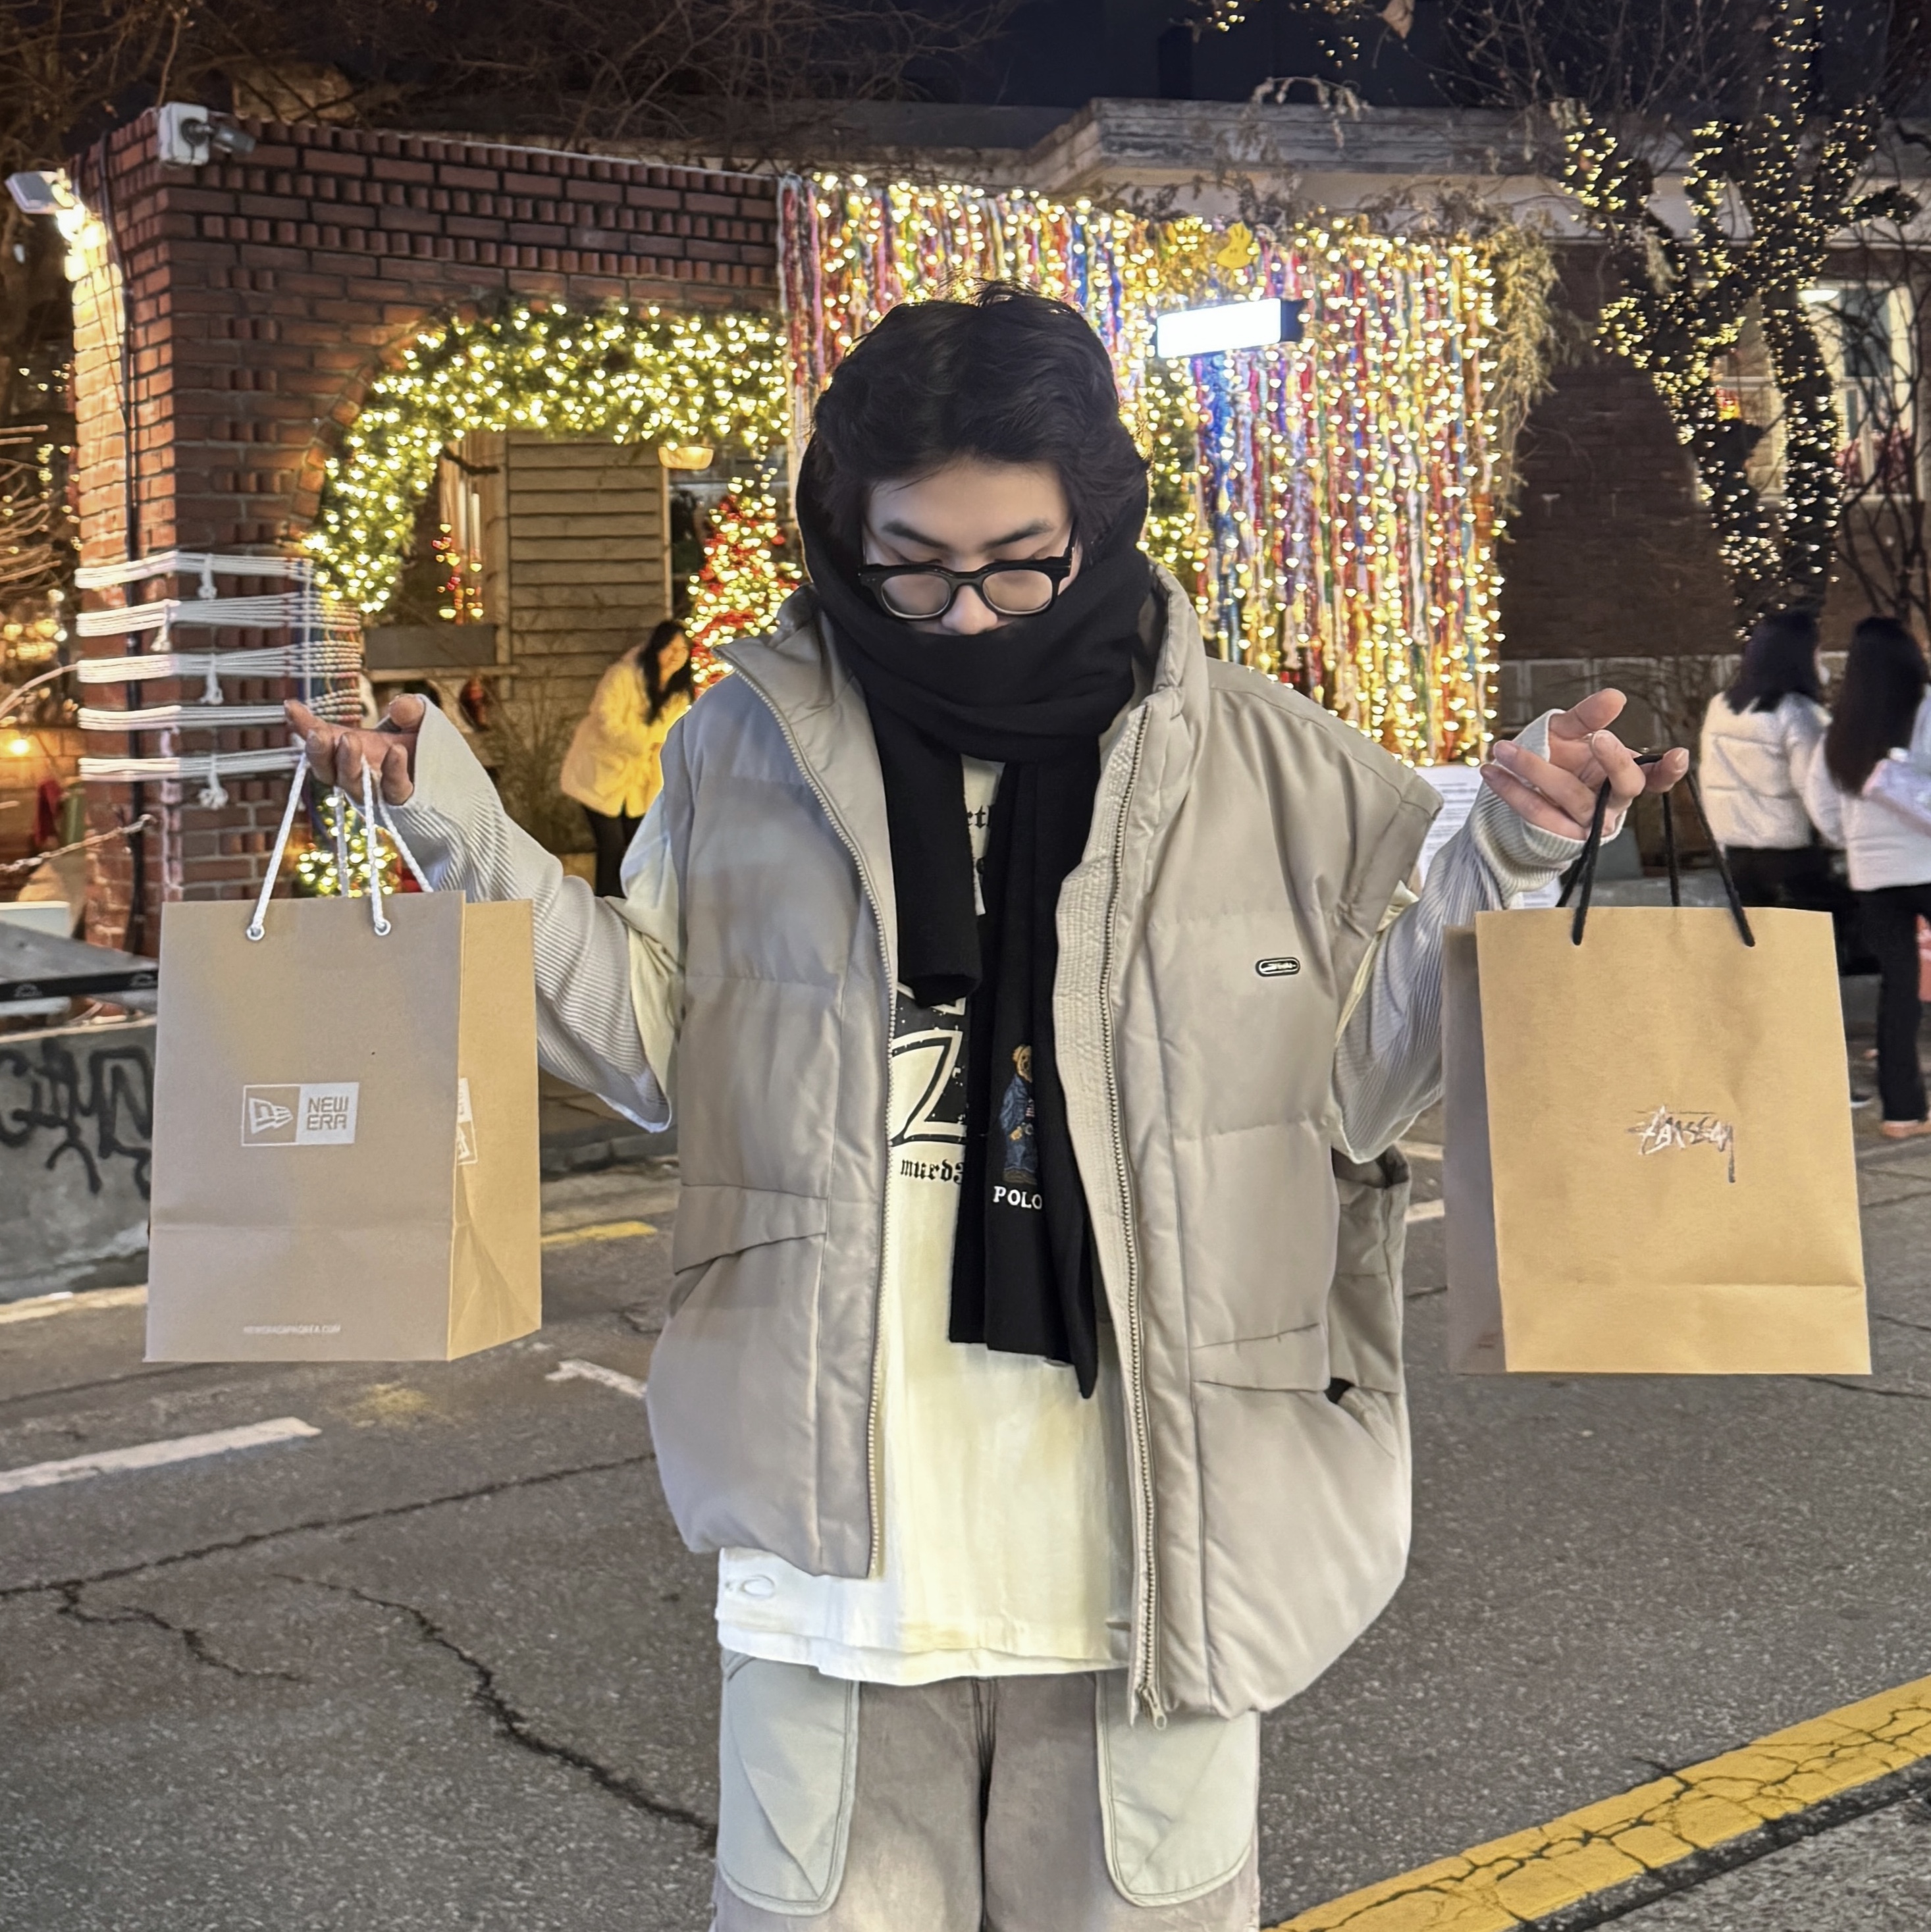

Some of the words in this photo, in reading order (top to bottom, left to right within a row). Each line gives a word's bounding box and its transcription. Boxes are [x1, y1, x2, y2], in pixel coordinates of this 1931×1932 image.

[307, 1096, 349, 1113] NEW
[306, 1113, 348, 1131] ERA
[992, 1186, 1043, 1210] POLO
